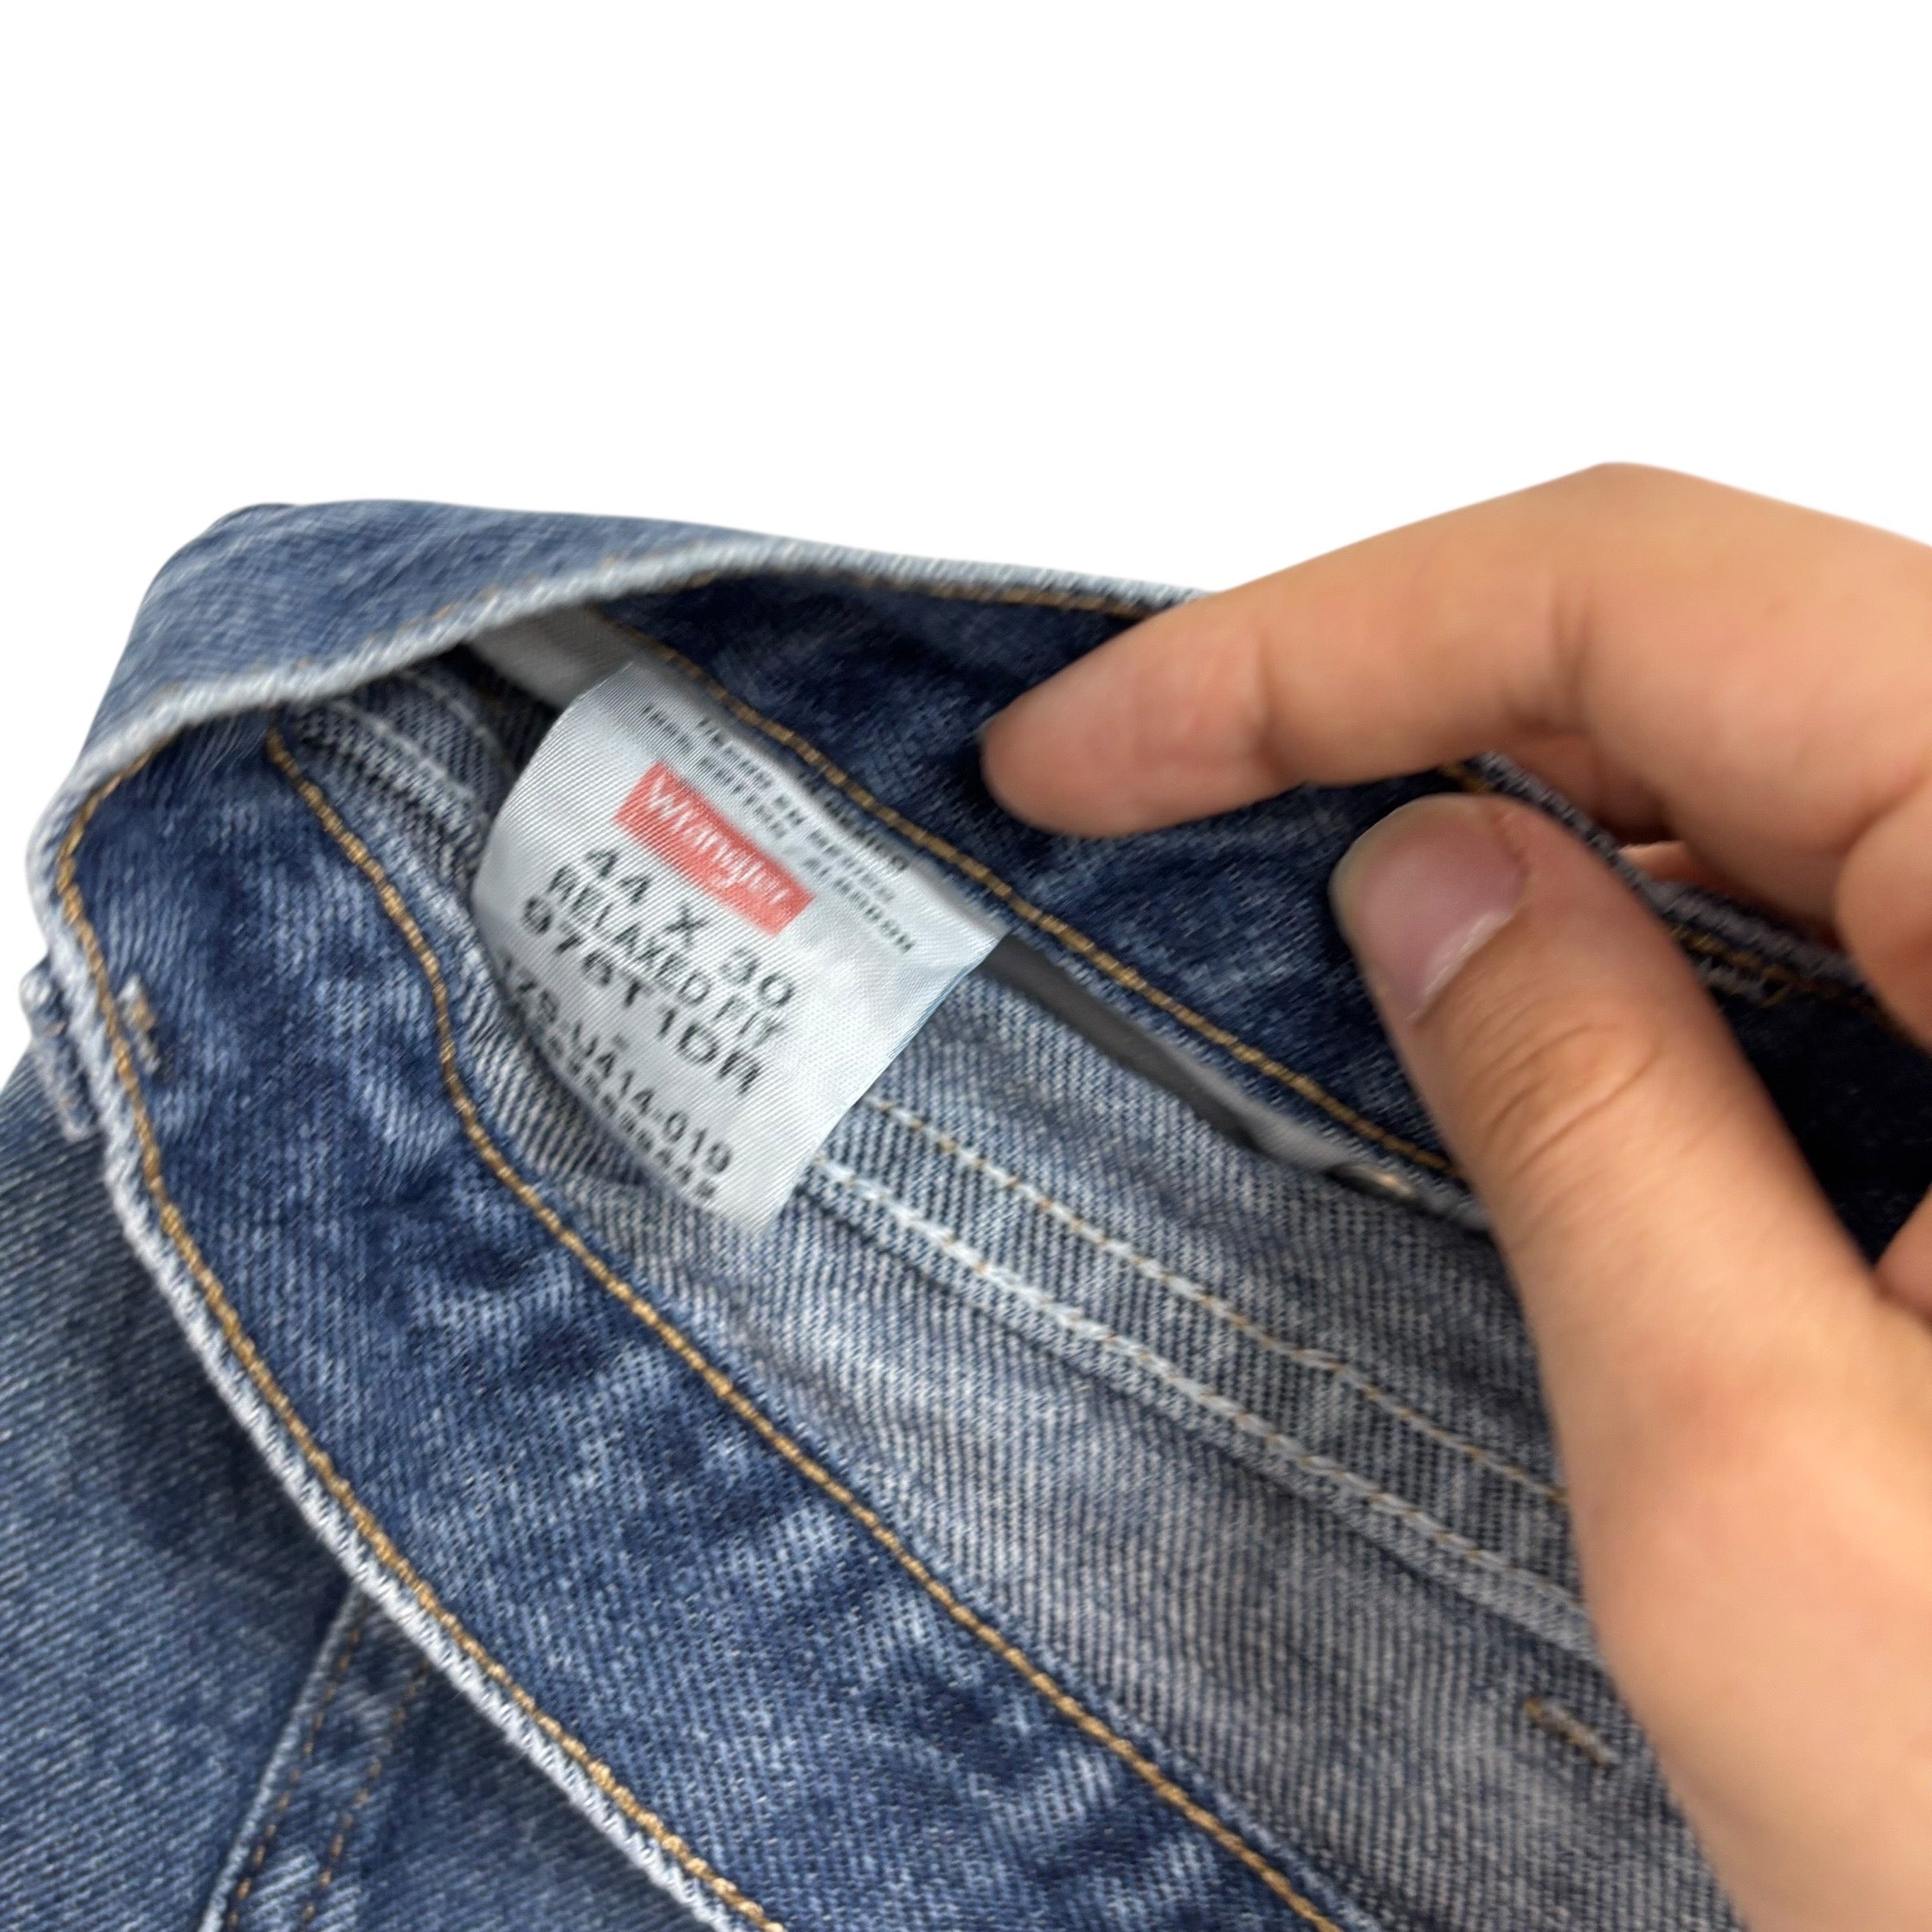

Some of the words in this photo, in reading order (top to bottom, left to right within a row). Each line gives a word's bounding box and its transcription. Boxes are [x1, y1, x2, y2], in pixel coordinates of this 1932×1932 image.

[646, 770, 791, 906] Wrangler
[545, 865, 713, 1005] RELAXED
[713, 994, 787, 1047] FIT
[585, 848, 652, 905] 44
[719, 948, 796, 1008] 30
